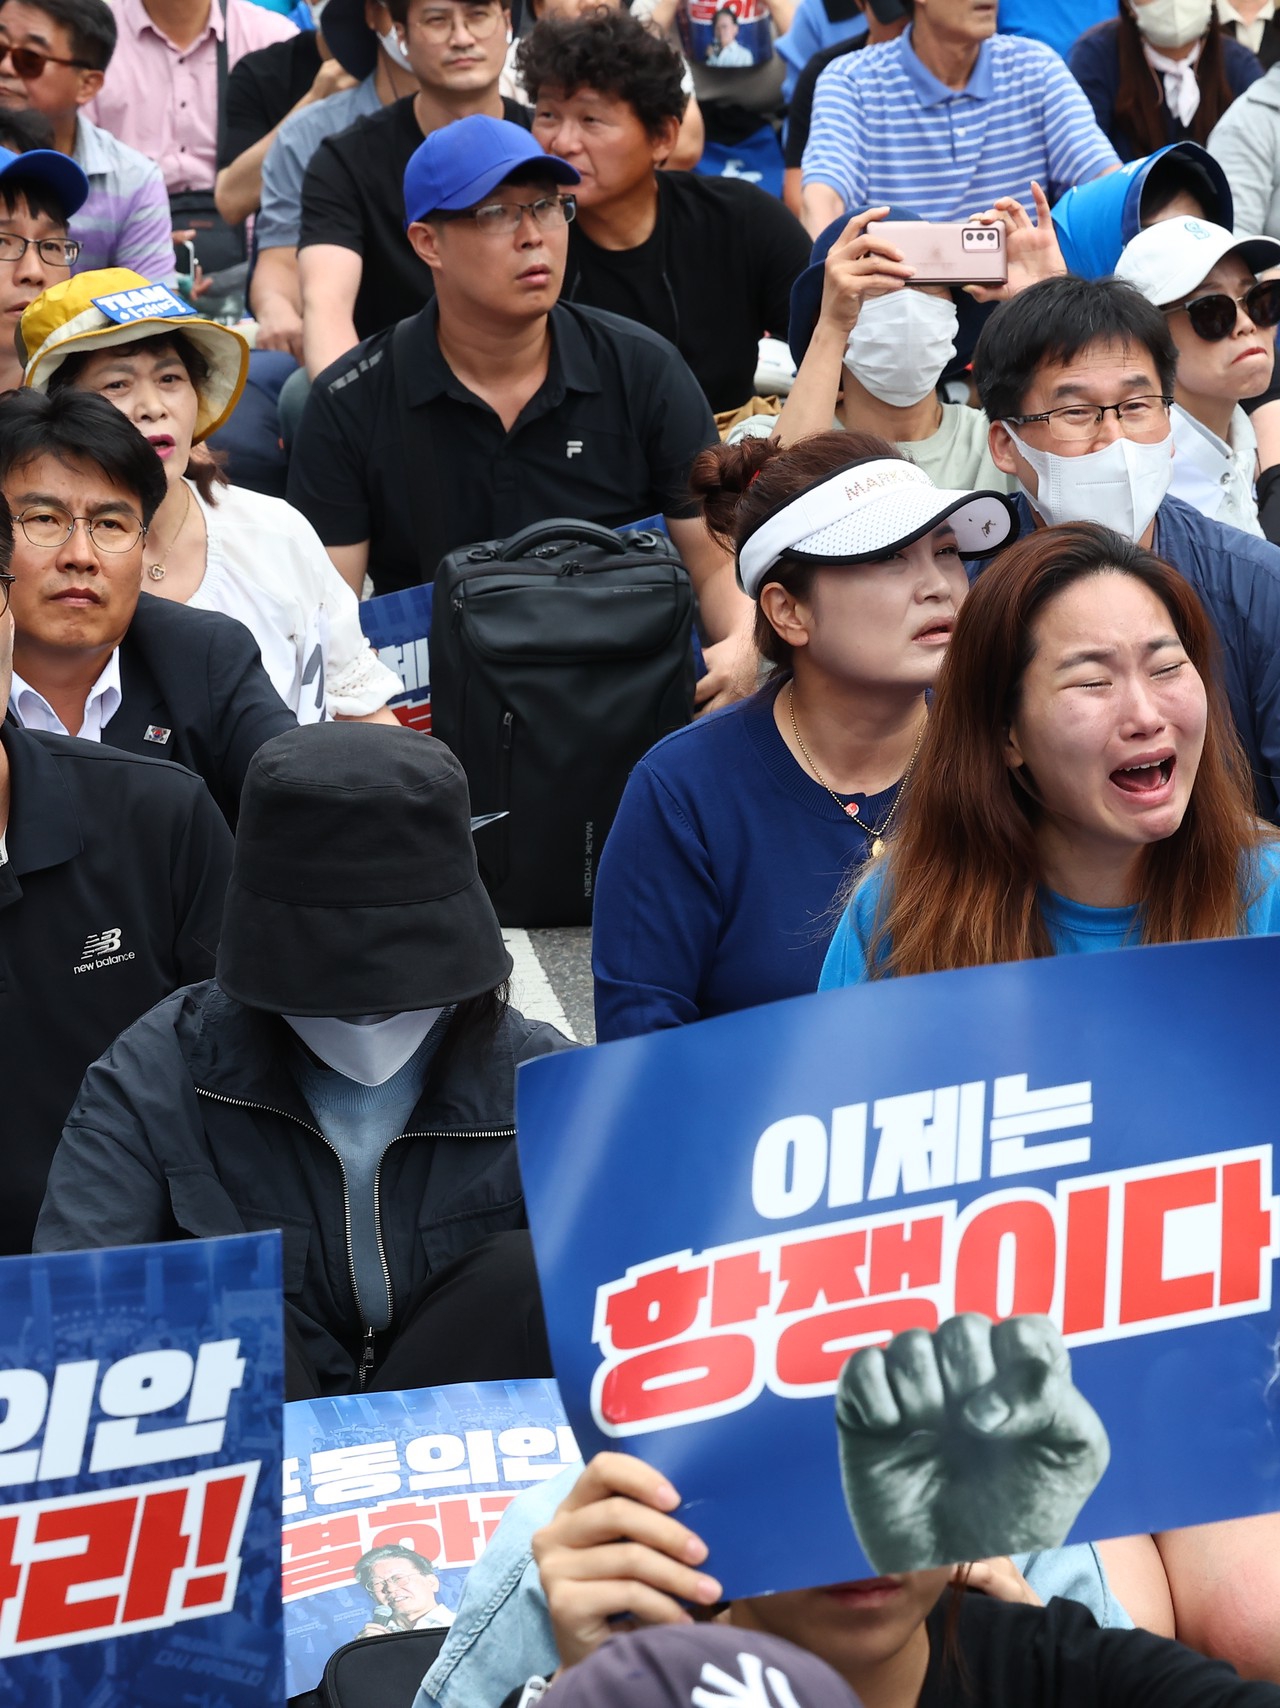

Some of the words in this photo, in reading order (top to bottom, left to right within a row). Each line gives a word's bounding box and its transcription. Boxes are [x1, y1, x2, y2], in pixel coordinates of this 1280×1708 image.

[73, 962, 95, 975] new
[95, 951, 136, 969] balance
[751, 1073, 1093, 1220] 이제는
[593, 1147, 1280, 1436] 항쟁이다
